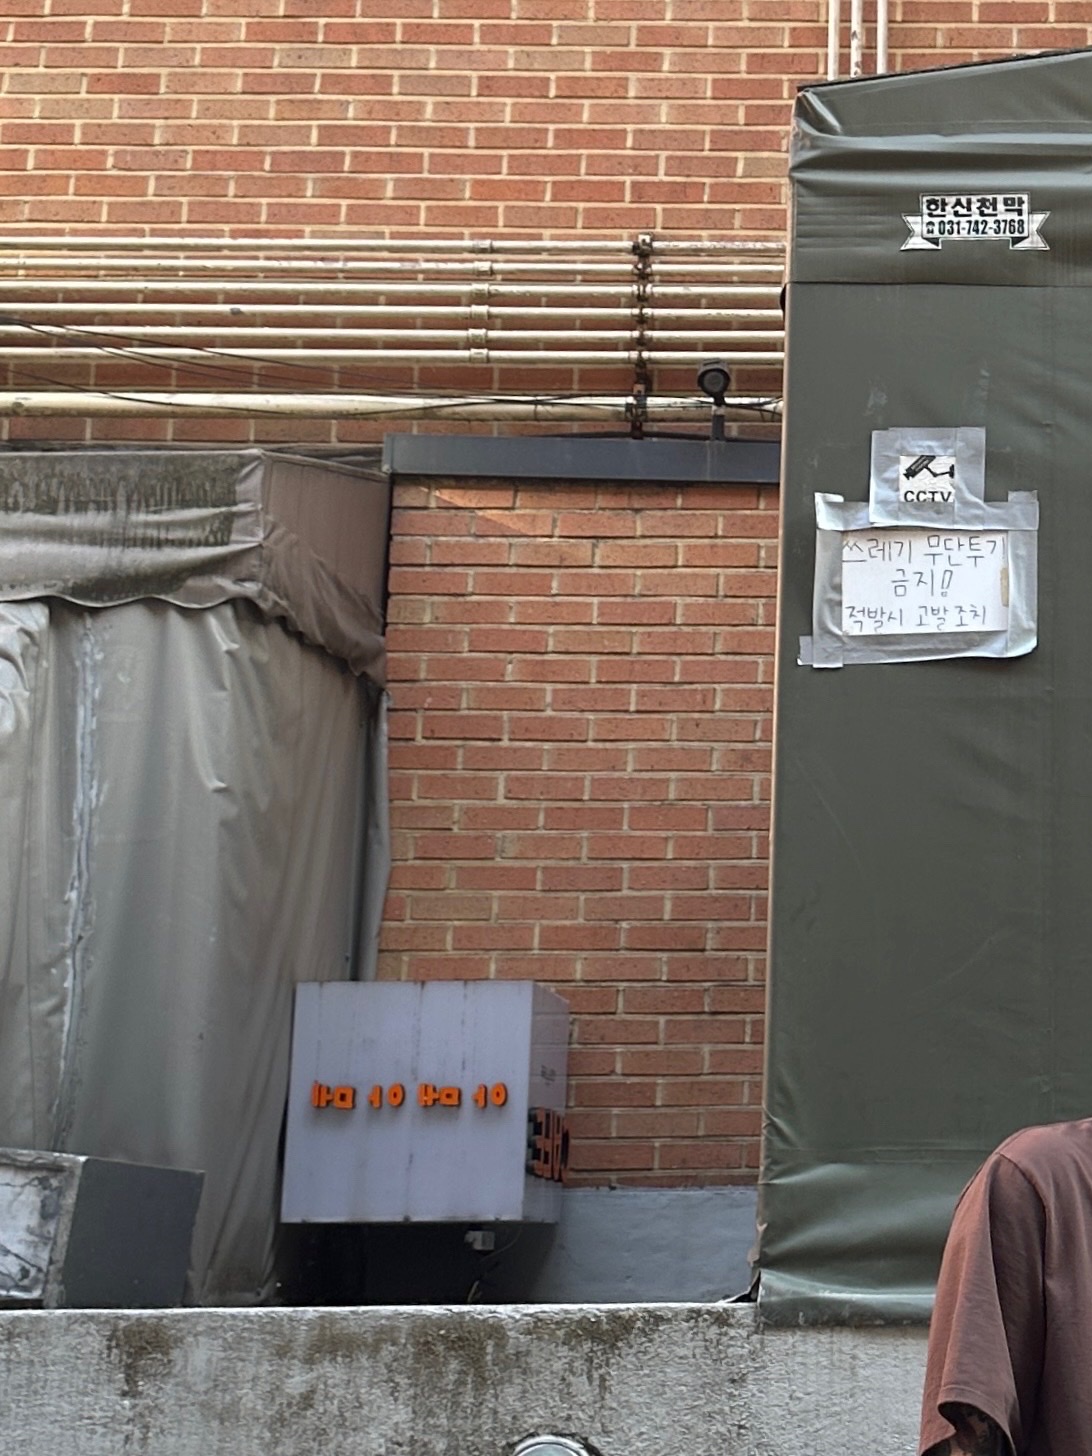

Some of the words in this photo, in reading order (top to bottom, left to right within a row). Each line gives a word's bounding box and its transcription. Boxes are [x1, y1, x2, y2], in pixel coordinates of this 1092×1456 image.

[925, 196, 1025, 218] 한신천막
[938, 219, 1025, 235] 031-742-3768
[903, 490, 953, 502] CCTV
[841, 538, 912, 563] 쓰레기
[923, 534, 1006, 567] 무단투기
